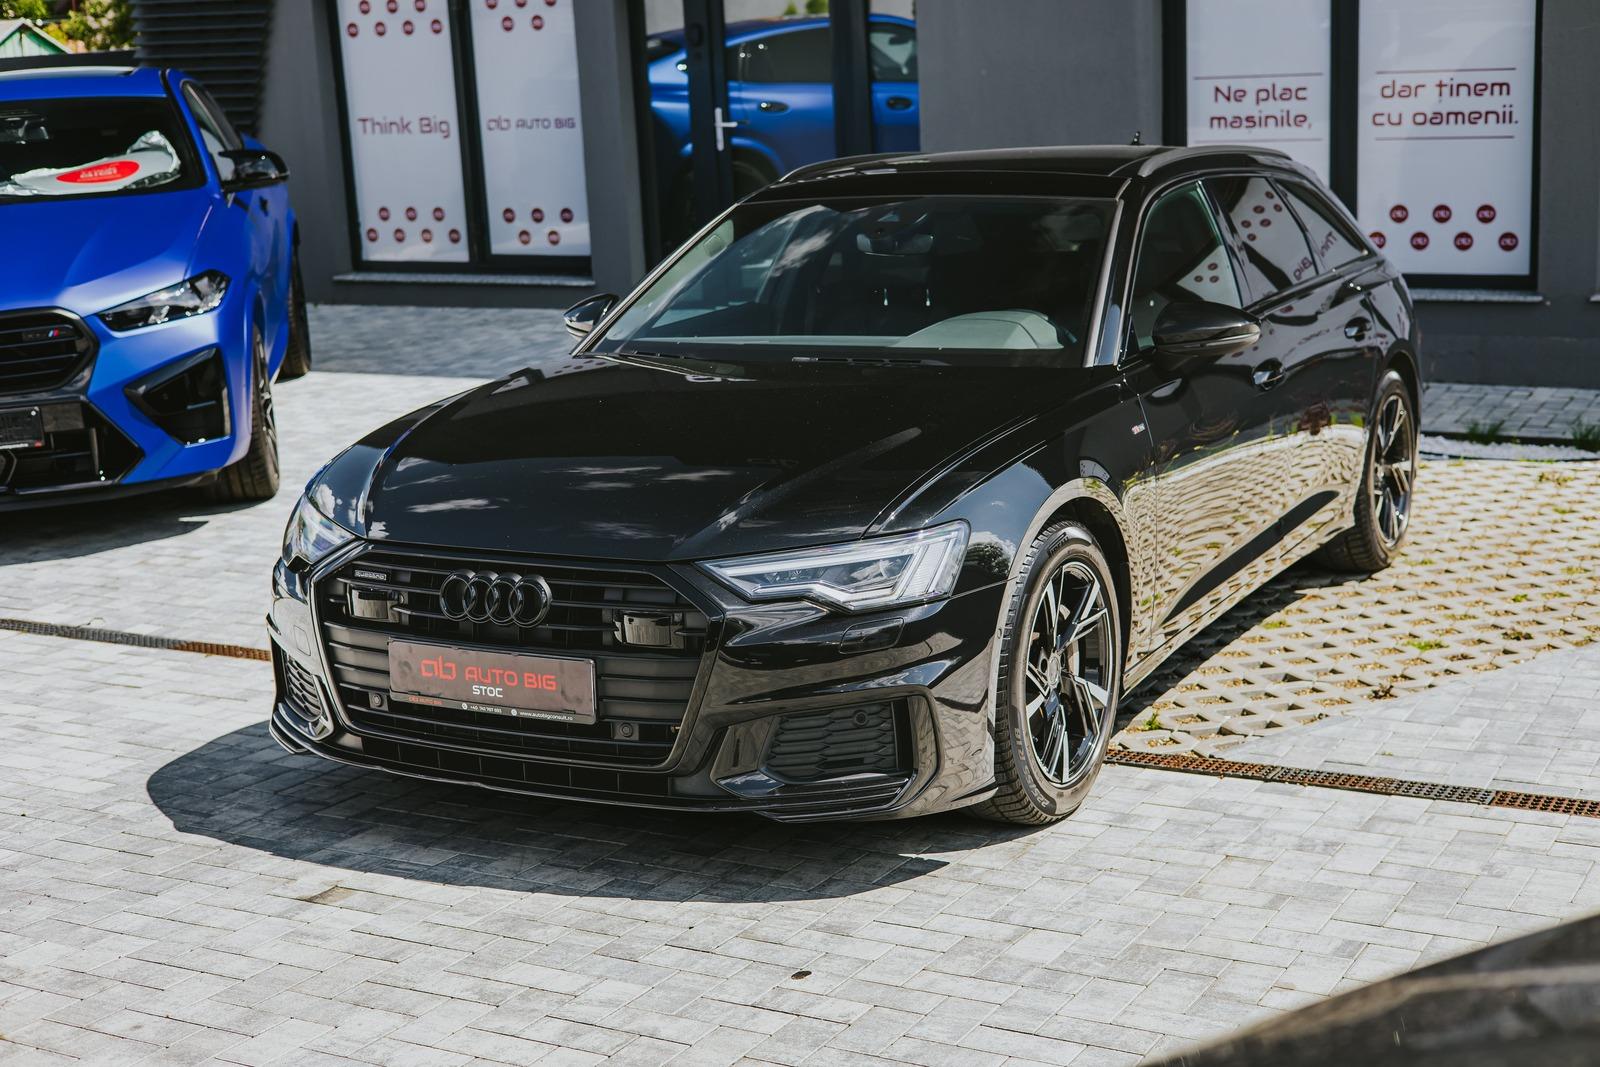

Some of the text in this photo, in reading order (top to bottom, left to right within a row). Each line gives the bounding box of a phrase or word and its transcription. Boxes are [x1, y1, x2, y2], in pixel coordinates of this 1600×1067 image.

[1214, 82, 1307, 106] Ne plac
[1381, 79, 1426, 98] dar
[515, 117, 551, 130] AUTO
[554, 117, 576, 130] BIG
[1372, 104, 1519, 126] cu oamenii.
[358, 116, 451, 138] Think Big
[465, 666, 519, 687] AUTO
[523, 672, 558, 691] BIG
[472, 684, 503, 698] STOC
